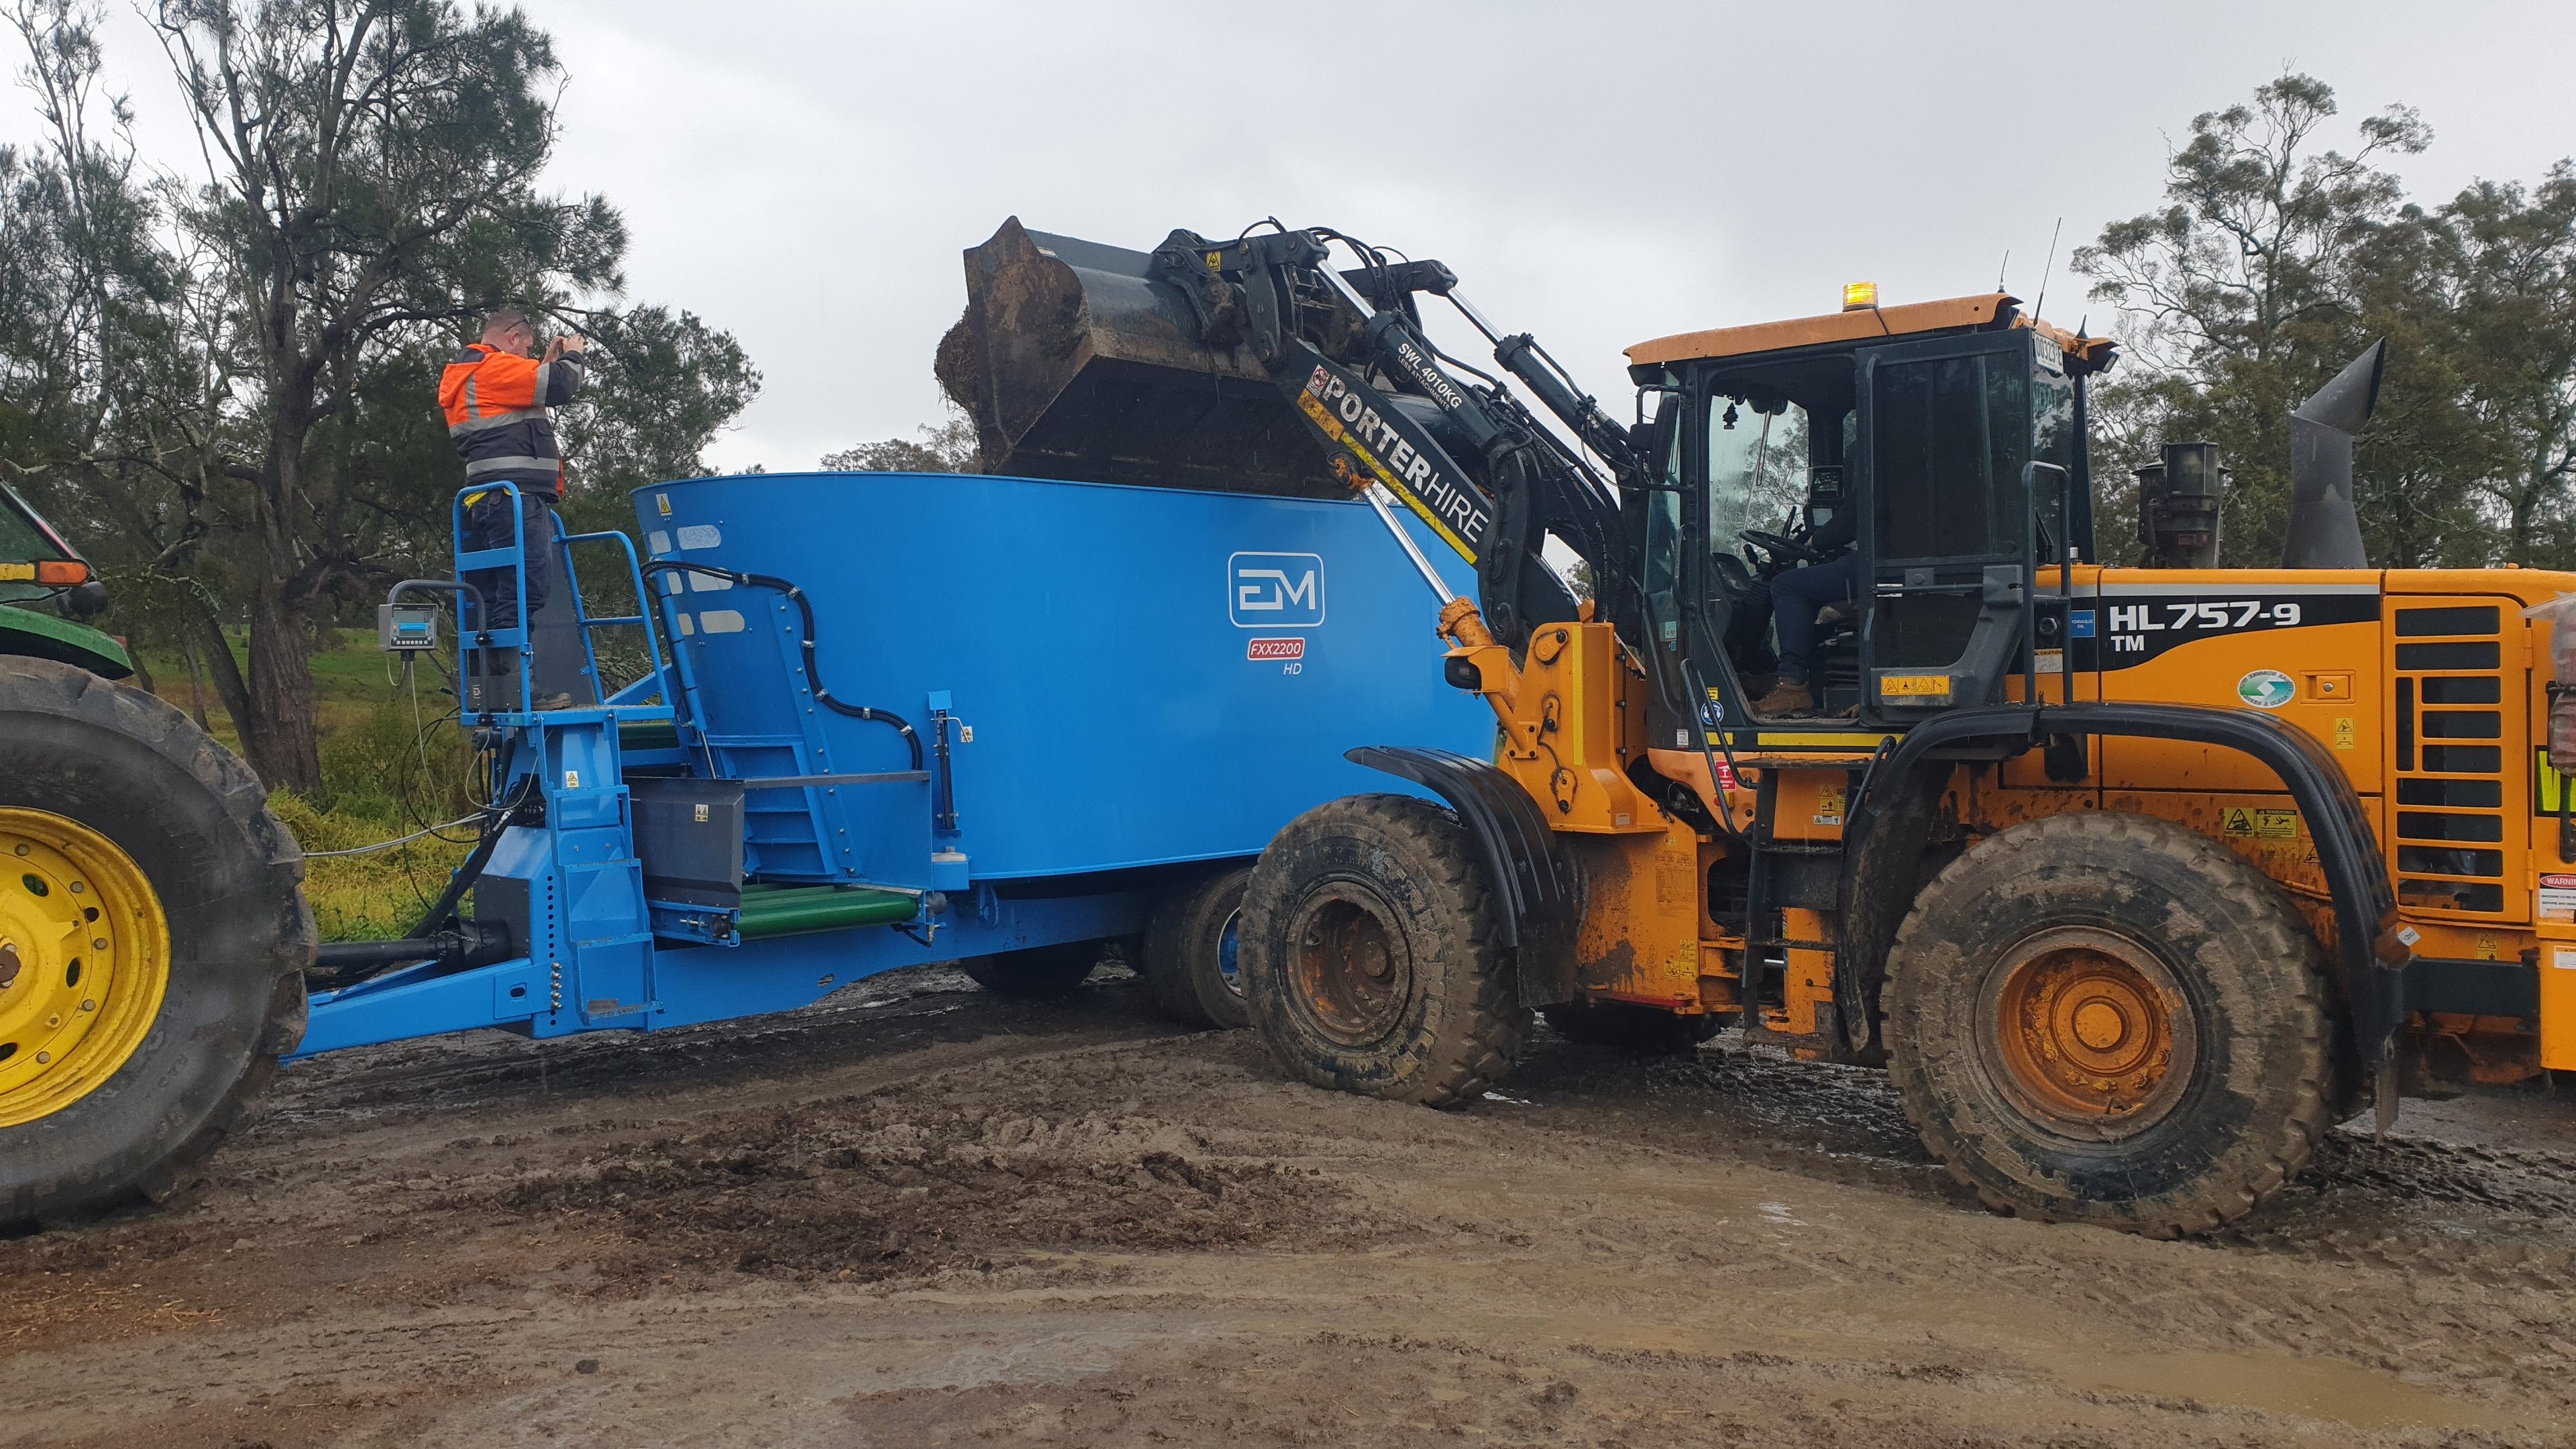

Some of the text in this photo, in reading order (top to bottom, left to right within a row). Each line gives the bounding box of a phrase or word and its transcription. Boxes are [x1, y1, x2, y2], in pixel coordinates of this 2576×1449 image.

[1397, 355, 1450, 411] LESS ATTACHMENTS
[1399, 343, 1462, 409] SWL 4010KG
[1238, 569, 1316, 610] EM
[2110, 600, 2301, 631] HL757-9
[1250, 643, 1301, 655] FXX2200
[2110, 635, 2145, 651] TM
[1283, 663, 1302, 675] HD
